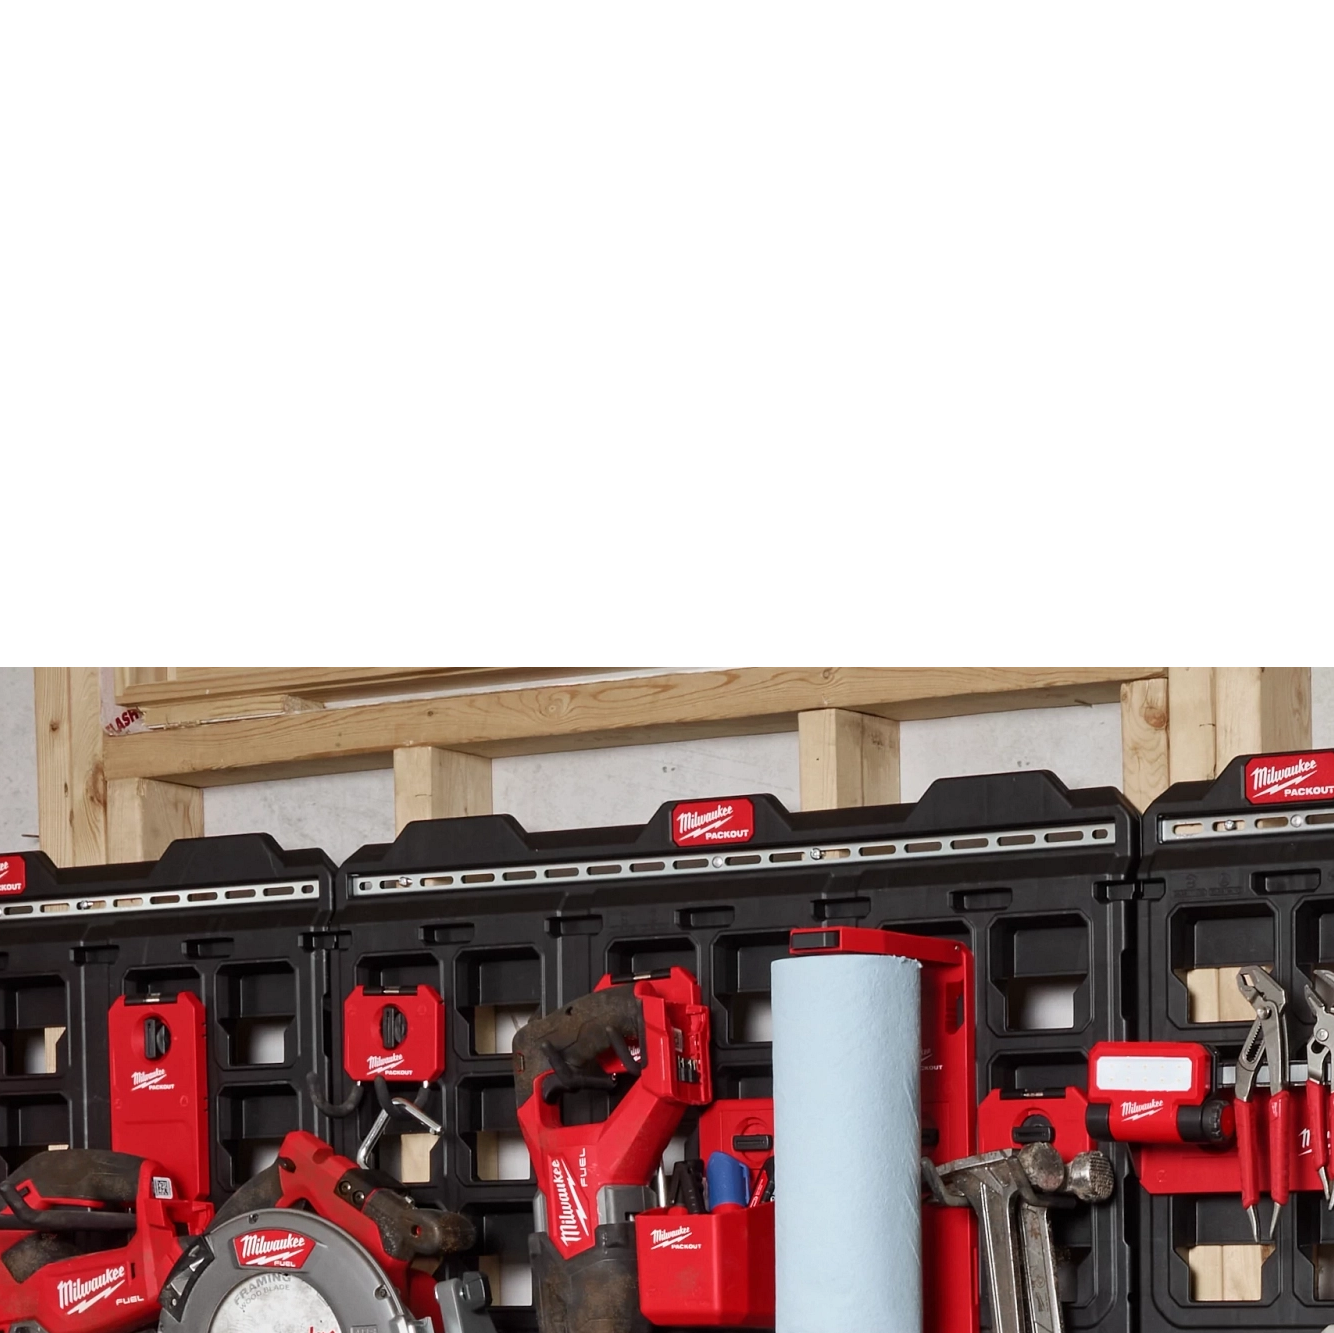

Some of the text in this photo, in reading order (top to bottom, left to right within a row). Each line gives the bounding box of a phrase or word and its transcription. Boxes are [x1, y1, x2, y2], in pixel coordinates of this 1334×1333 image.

[1250, 758, 1317, 791] Milwaukee
[1284, 785, 1334, 797] PACKOUT
[676, 804, 734, 834] Milwaukee
[705, 829, 749, 840] PACKOUT
[366, 1052, 403, 1072] Milwaukee
[384, 1068, 413, 1076] PACKOUT
[131, 1068, 166, 1087] Milwaukee
[149, 1083, 175, 1091] PACKOUT
[1120, 1098, 1164, 1117] Milwaukee
[578, 1147, 588, 1188] FUEL
[551, 1158, 583, 1247] Milwaukee
[650, 1225, 690, 1245] Milwaukee
[239, 1232, 306, 1260] Milwaukee
[273, 1260, 296, 1268] FUEL
[57, 1264, 126, 1310] Milwaukee
[234, 1272, 292, 1305] FRAMING
[115, 1295, 145, 1306] FUEL
